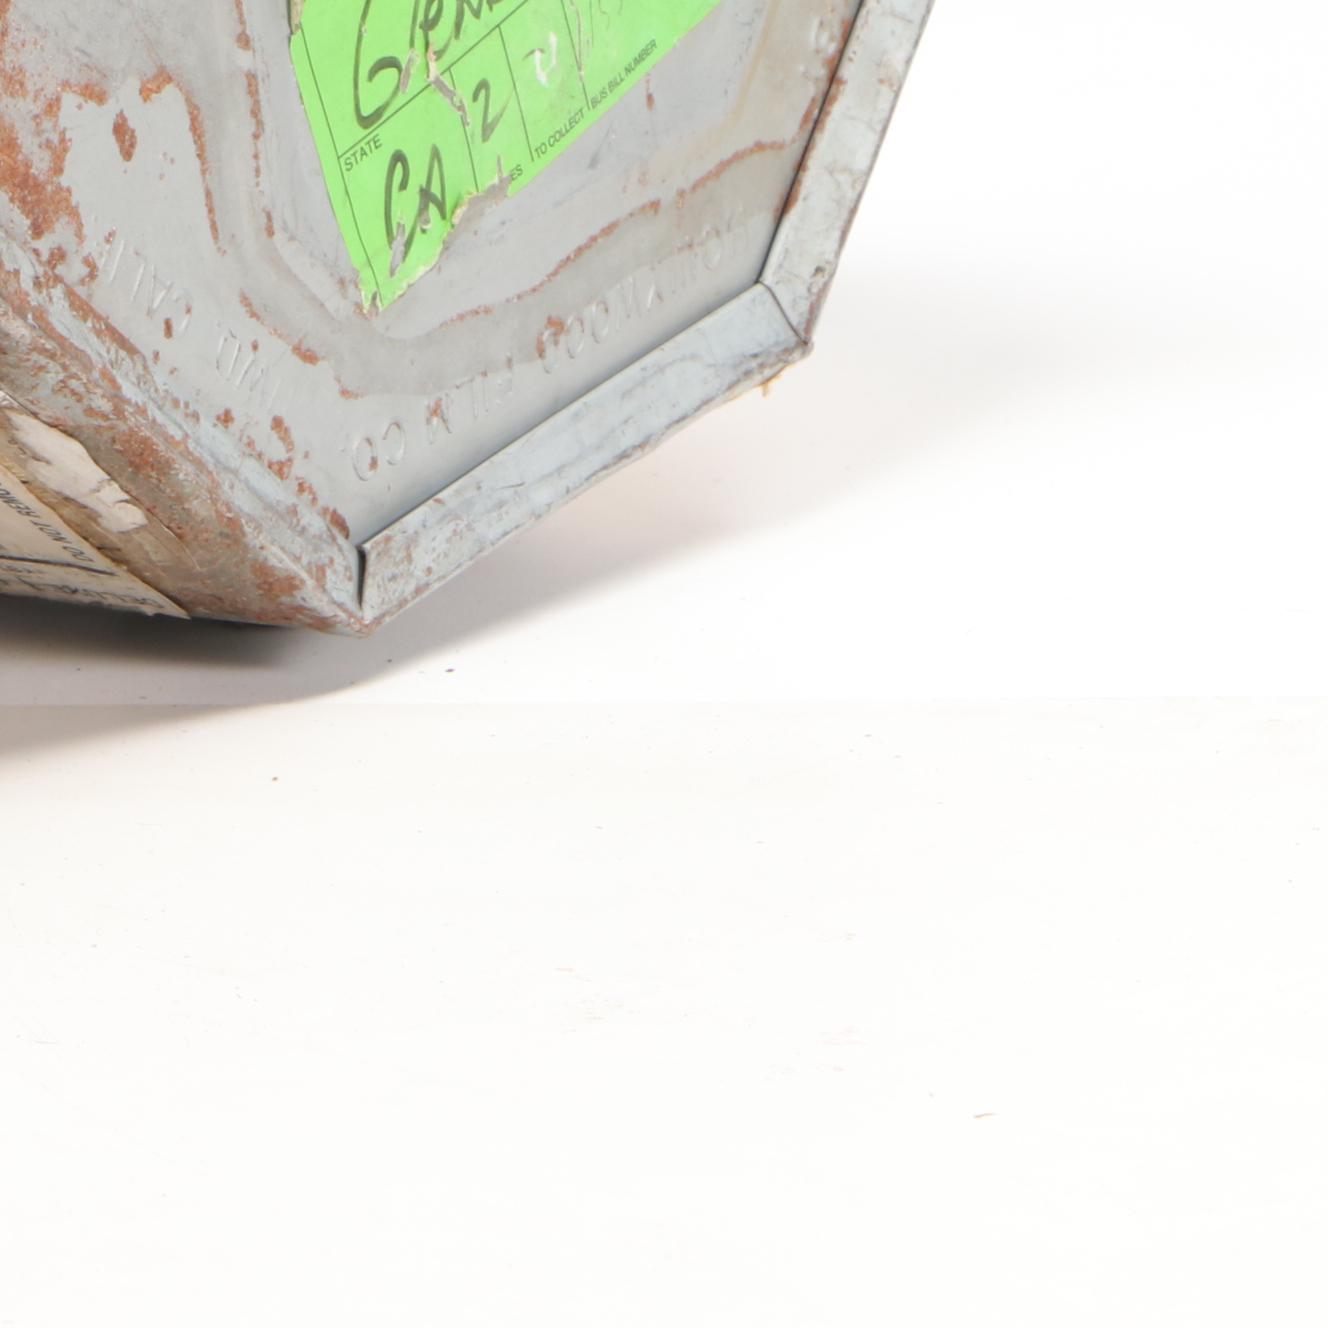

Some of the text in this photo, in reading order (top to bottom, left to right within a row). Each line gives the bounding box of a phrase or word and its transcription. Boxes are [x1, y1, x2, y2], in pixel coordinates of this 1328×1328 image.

[590, 38, 659, 110] BUS BILL NUMBER
[534, 108, 586, 159] TO COLLECT
[344, 135, 383, 173] STATE
[29, 519, 73, 545] NOT
[61, 545, 95, 563] DO
